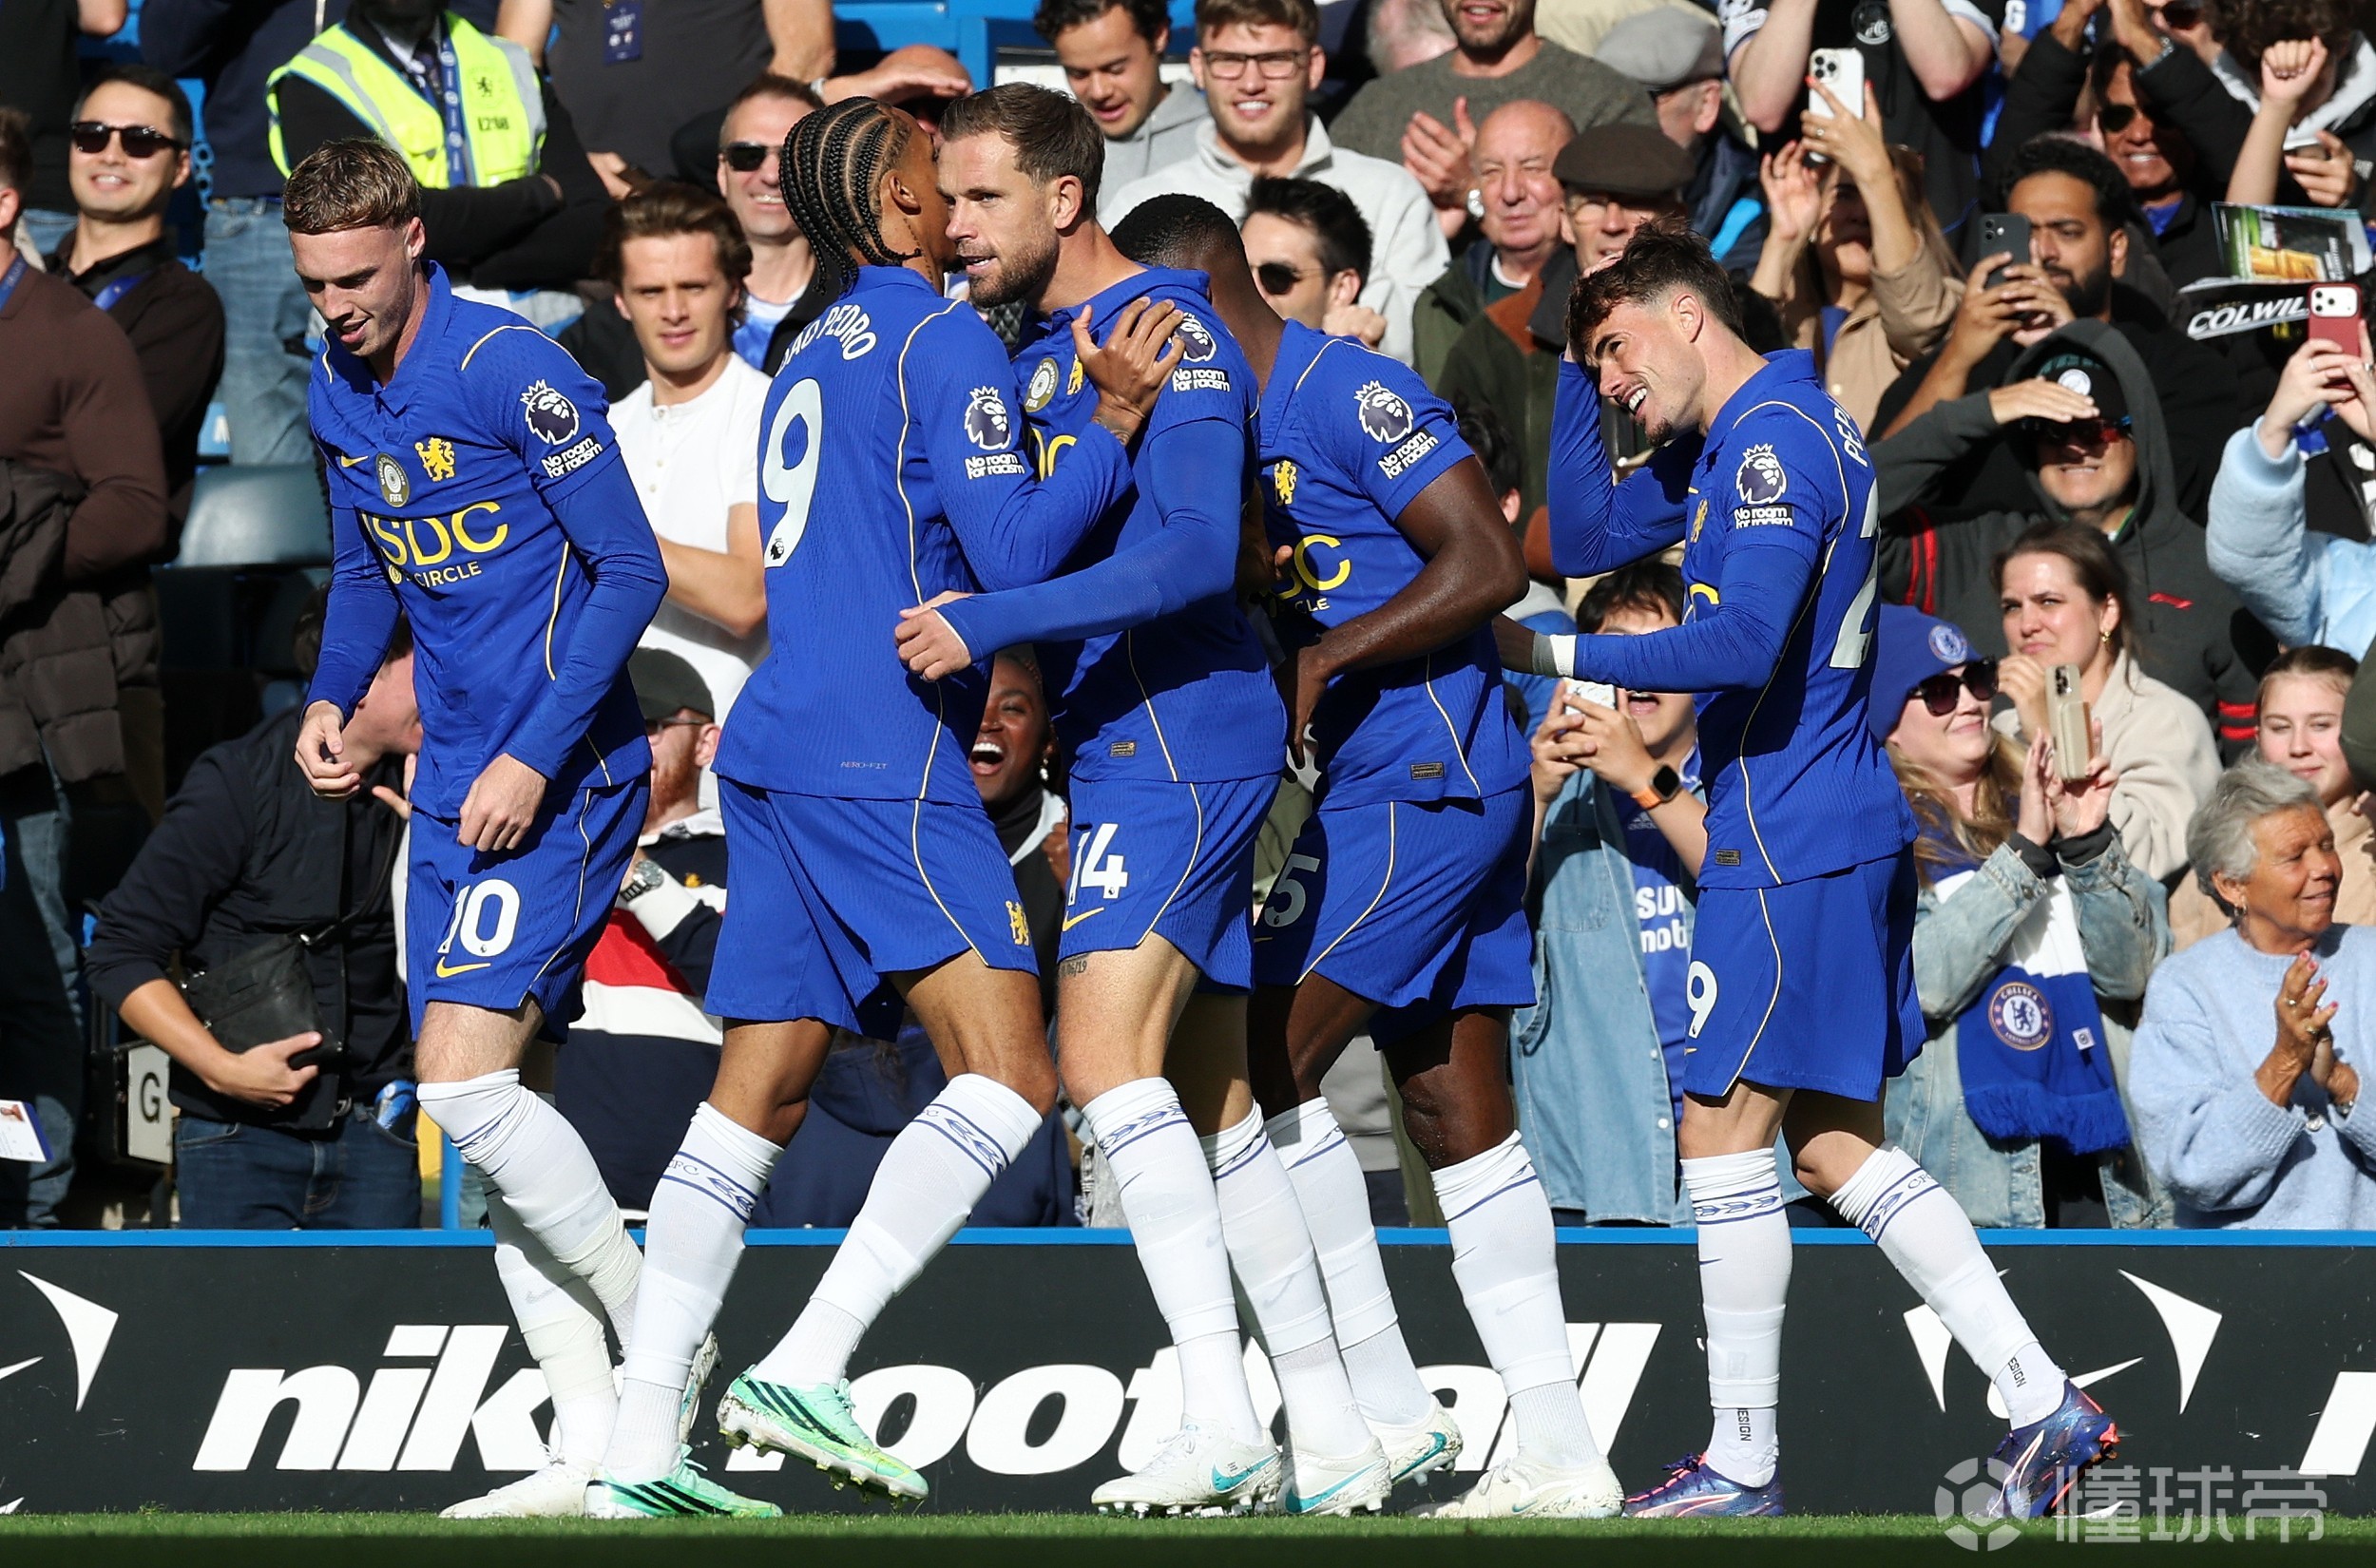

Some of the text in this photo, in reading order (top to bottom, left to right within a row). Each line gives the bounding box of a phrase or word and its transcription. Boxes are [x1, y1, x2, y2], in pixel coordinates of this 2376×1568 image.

[815, 304, 877, 360] PEDRO
[2187, 296, 2309, 335] COLWIL
[1173, 368, 1226, 381] No room
[1173, 378, 1231, 392] for racism
[542, 437, 594, 469] No room
[546, 443, 604, 479] for racism
[965, 453, 1018, 469] No room
[1378, 431, 1428, 468] No room
[1384, 436, 1439, 480] for racism
[763, 377, 823, 568] 9
[967, 464, 1025, 480] for racism
[1734, 507, 1788, 520] No room
[362, 501, 509, 566] SDC
[414, 561, 482, 587] CIRCLE
[1067, 823, 1129, 906] 14
[1264, 853, 1320, 927] 5
[437, 878, 520, 957] 10
[1686, 961, 1718, 1039] 9
[140, 1071, 162, 1123] G
[1907, 1174, 1932, 1190] CF
[193, 1323, 1662, 1476] nik ootall
[1737, 1408, 1752, 1442] ESIGN
